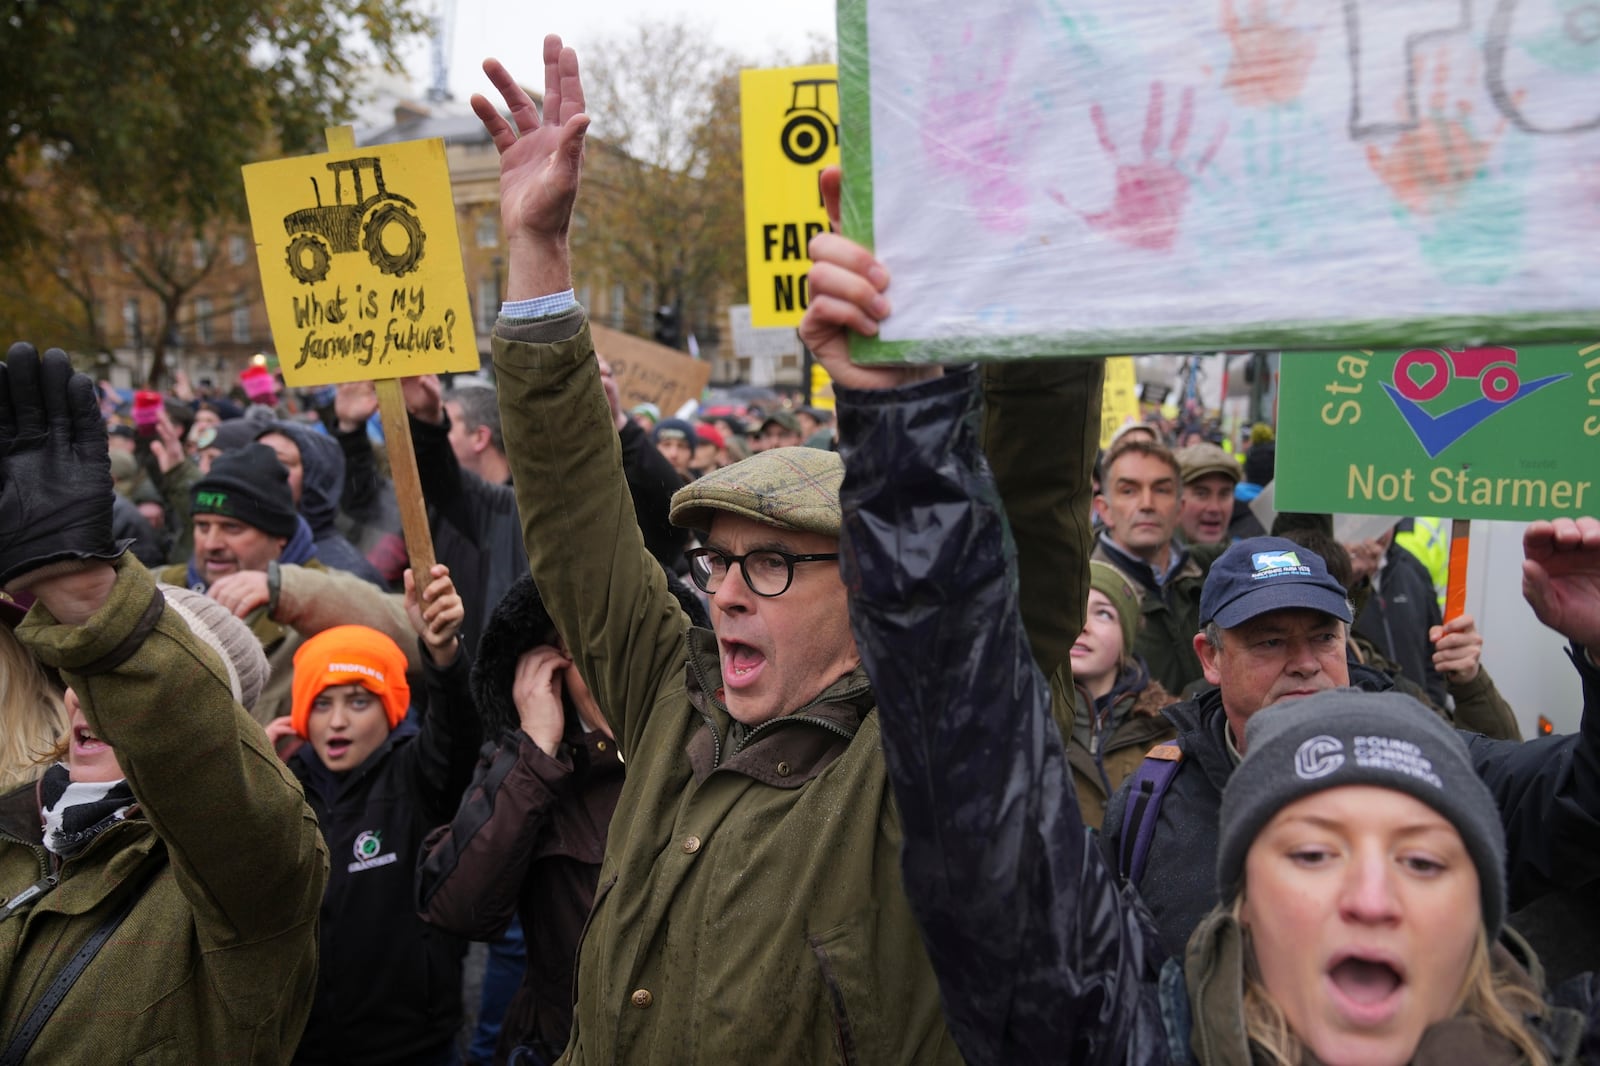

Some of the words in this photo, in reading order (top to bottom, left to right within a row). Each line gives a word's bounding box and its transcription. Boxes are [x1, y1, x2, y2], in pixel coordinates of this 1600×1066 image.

[292, 285, 348, 329] What
[356, 284, 379, 320] is
[295, 323, 376, 370] farming
[380, 308, 456, 364] future?
[1321, 349, 1375, 426] Sta
[1347, 464, 1416, 502] Not
[1428, 466, 1592, 509] Starmer
